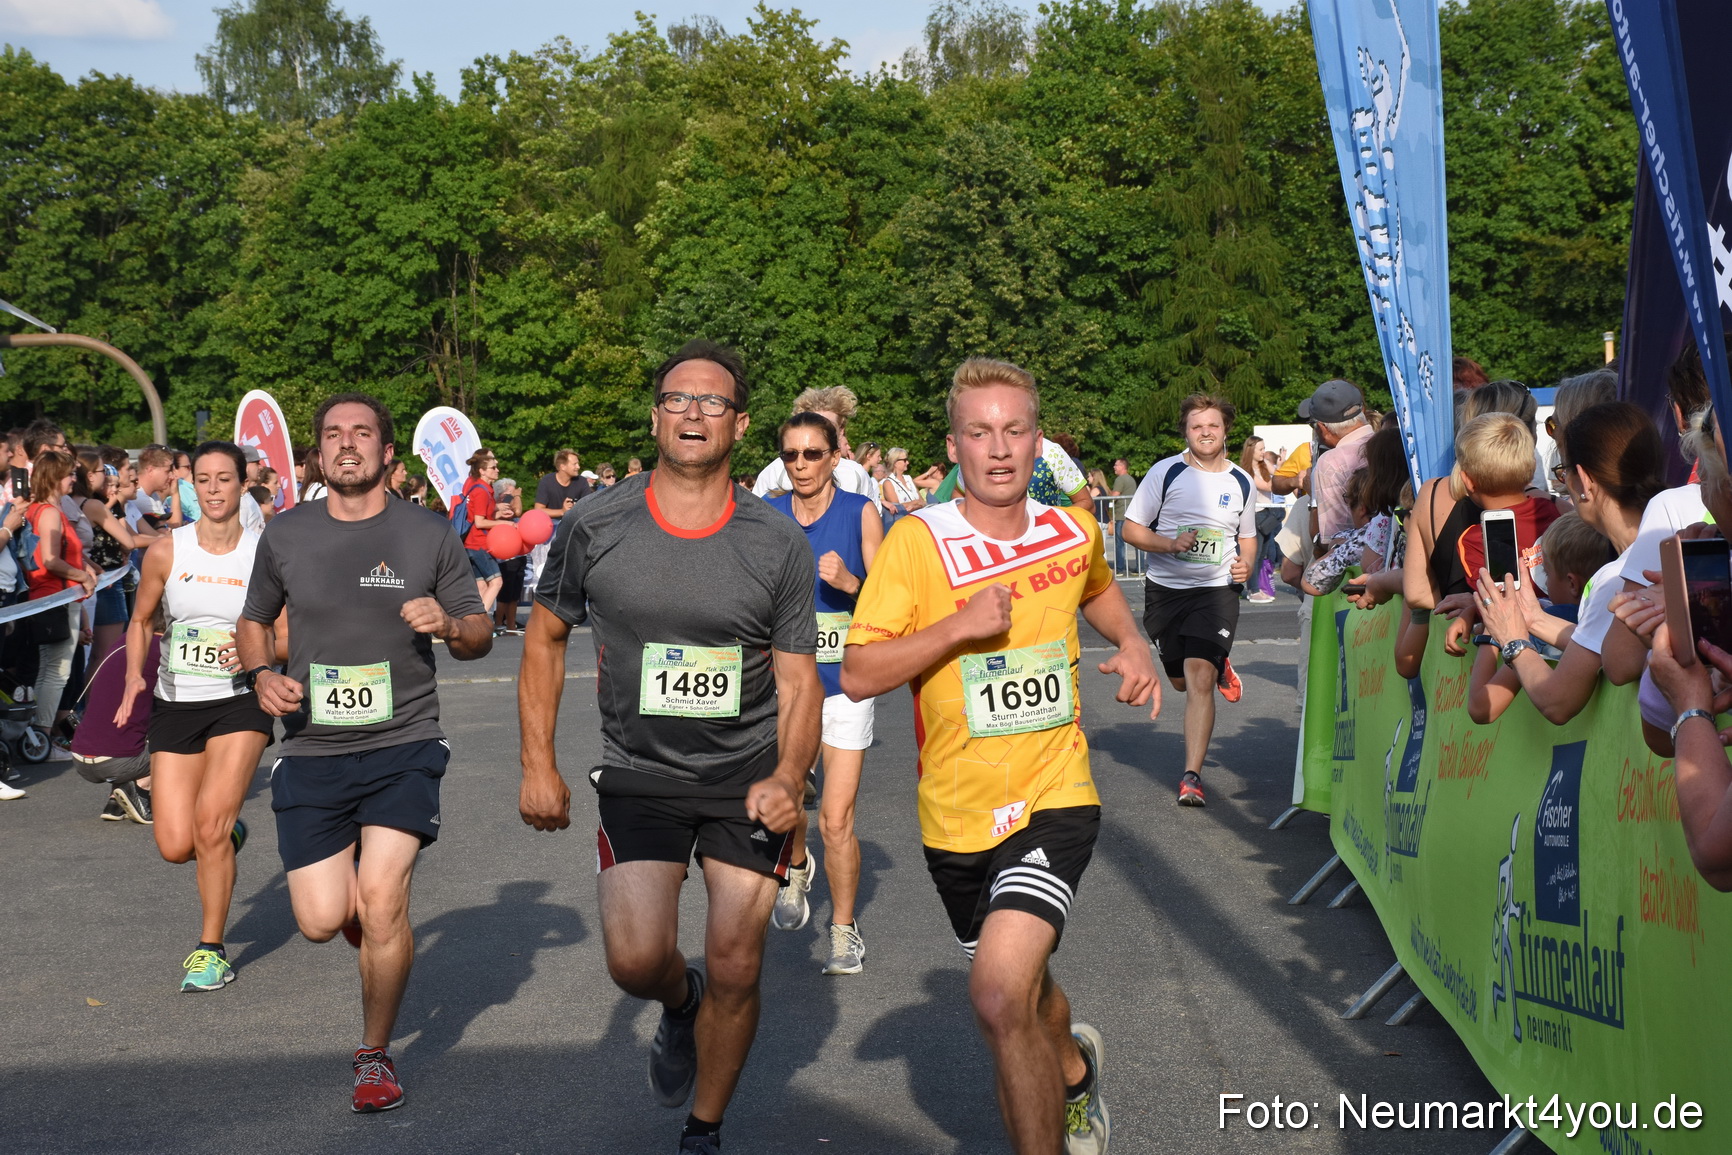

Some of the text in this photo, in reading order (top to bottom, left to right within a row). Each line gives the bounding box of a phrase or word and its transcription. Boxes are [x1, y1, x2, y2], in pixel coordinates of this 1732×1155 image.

[1191, 540, 1216, 555] 871
[360, 576, 405, 586] BURKHARDT
[1028, 554, 1090, 593] BÖGL
[197, 575, 247, 588] KLEBL
[658, 658, 698, 668] firmenlauf
[1048, 663, 1064, 673] 2019
[980, 664, 1023, 678] firmenlauf
[655, 670, 729, 697] 1489
[326, 687, 373, 709] 430
[980, 673, 1060, 713] 1690
[665, 696, 717, 706] Schmid Xaver
[346, 708, 378, 716] Korbinian
[991, 705, 1057, 722] Sturm Jonathan
[999, 720, 1014, 728] Bögl
[1015, 716, 1046, 726] Bauservice
[1047, 712, 1062, 720] GmbH
[1541, 797, 1573, 829] Fischer
[1543, 835, 1570, 847] AUTOMOBILE
[1020, 856, 1050, 868] adidas
[1519, 900, 1625, 1023] firmenlauf
[1527, 1012, 1573, 1054] neumarkt
